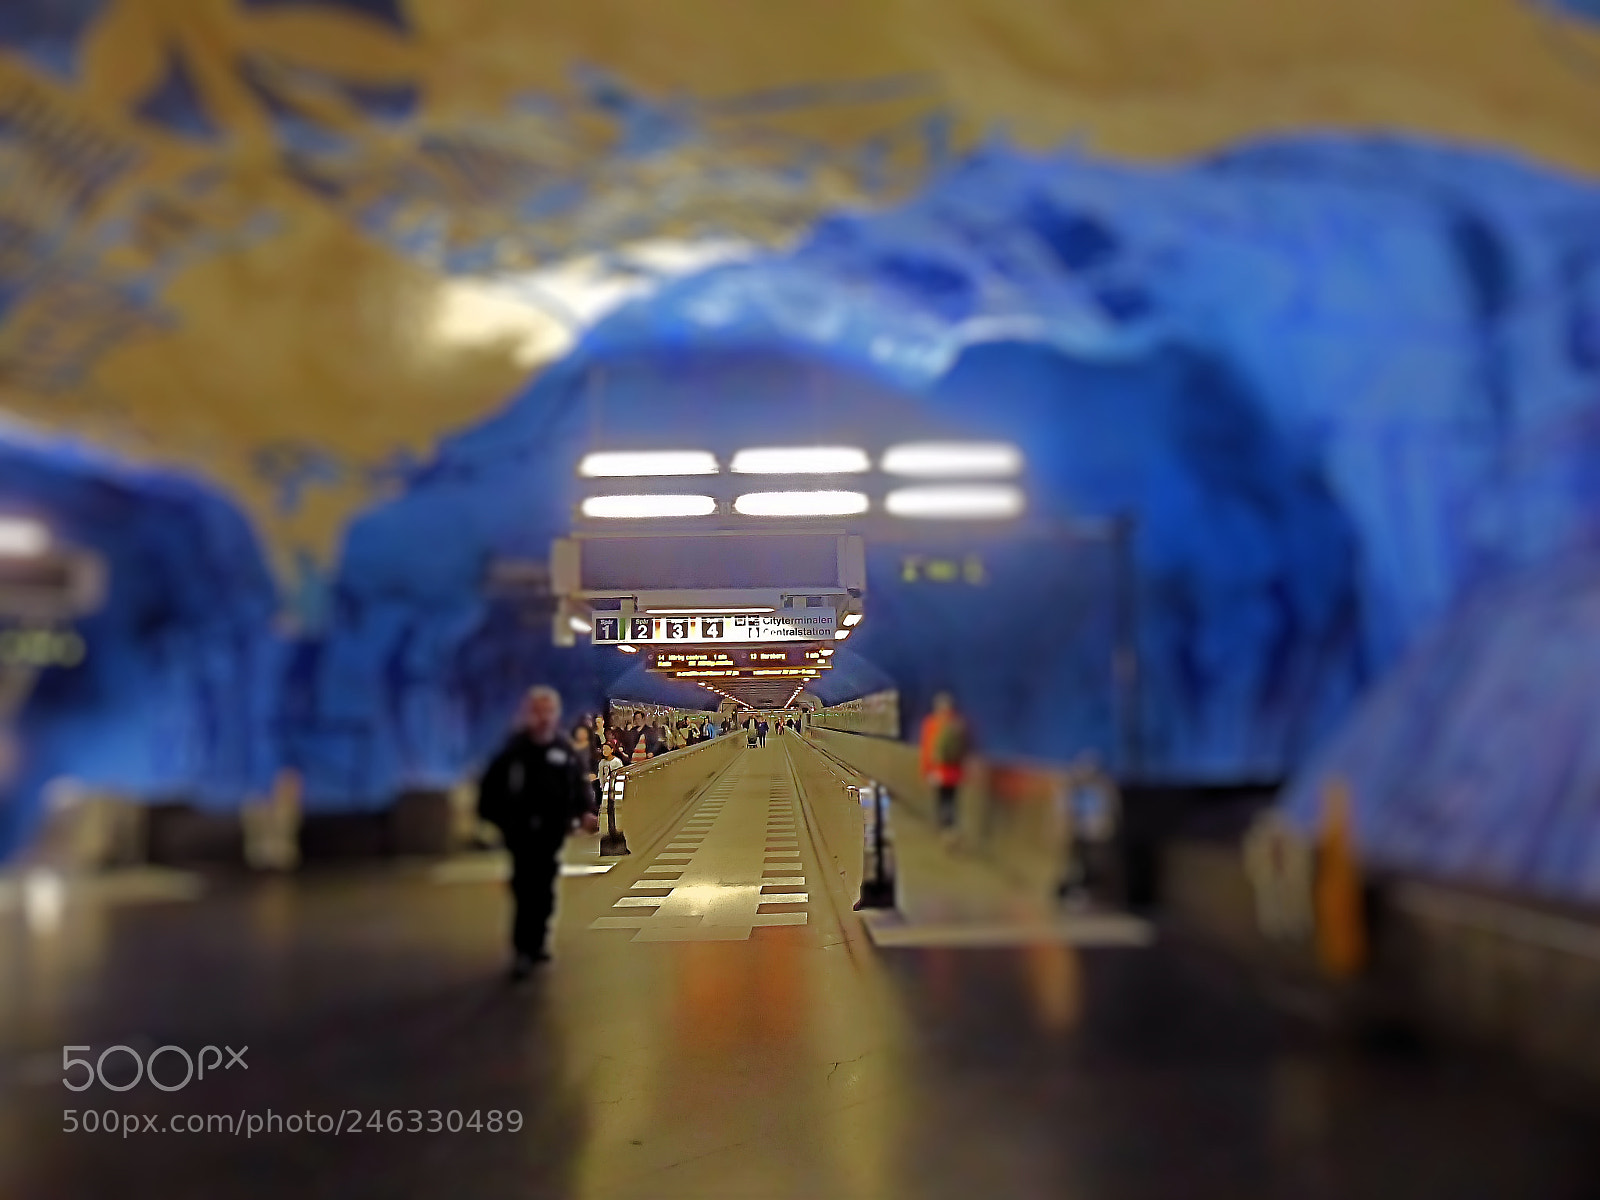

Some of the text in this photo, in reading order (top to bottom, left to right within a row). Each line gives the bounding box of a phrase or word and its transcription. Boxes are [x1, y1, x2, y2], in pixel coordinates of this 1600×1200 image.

[763, 615, 833, 627] Cityterminalen
[602, 625, 610, 639] 1
[637, 624, 648, 639] 2
[672, 624, 684, 639] 3
[706, 624, 719, 639] 4
